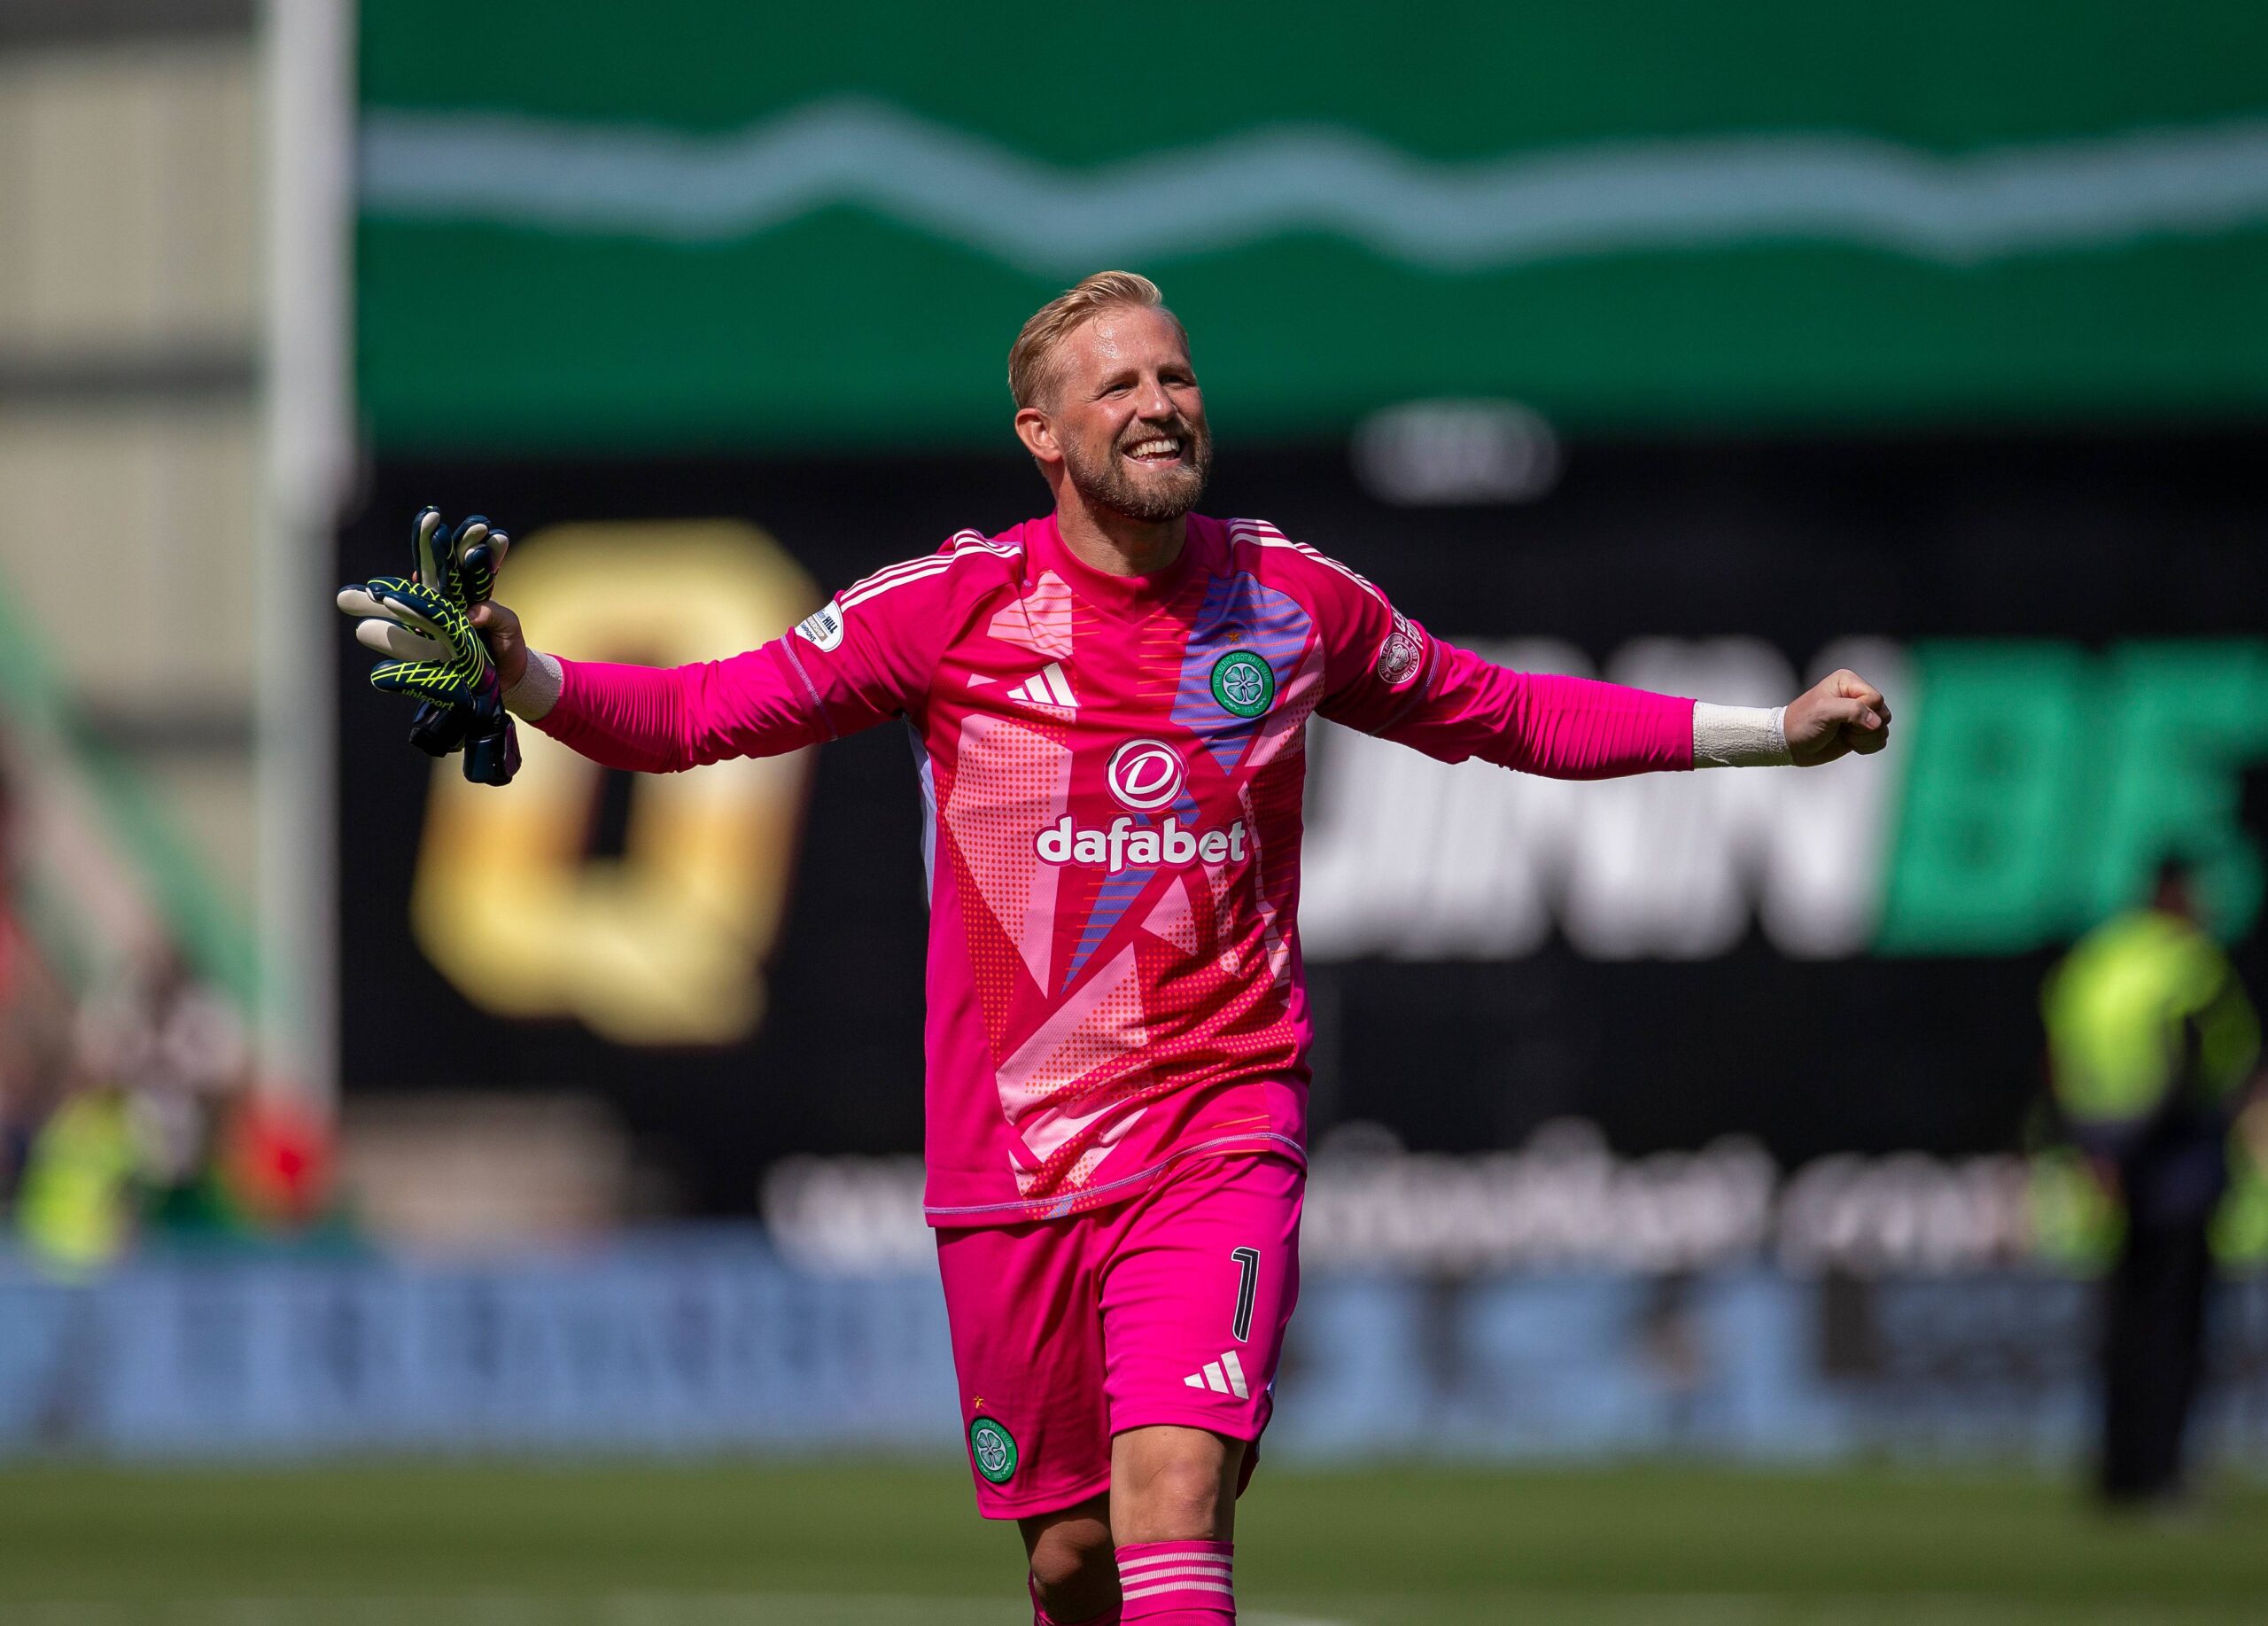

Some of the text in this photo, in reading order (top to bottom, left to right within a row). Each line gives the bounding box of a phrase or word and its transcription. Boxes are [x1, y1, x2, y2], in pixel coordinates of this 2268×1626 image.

[822, 616, 838, 634] HILL
[1216, 657, 1232, 677] CELTIC
[1231, 654, 1262, 669] FOOTBALL
[401, 689, 454, 710] uhlsport
[1037, 816, 1246, 872] dafabet
[1231, 1246, 1260, 1342] 1
